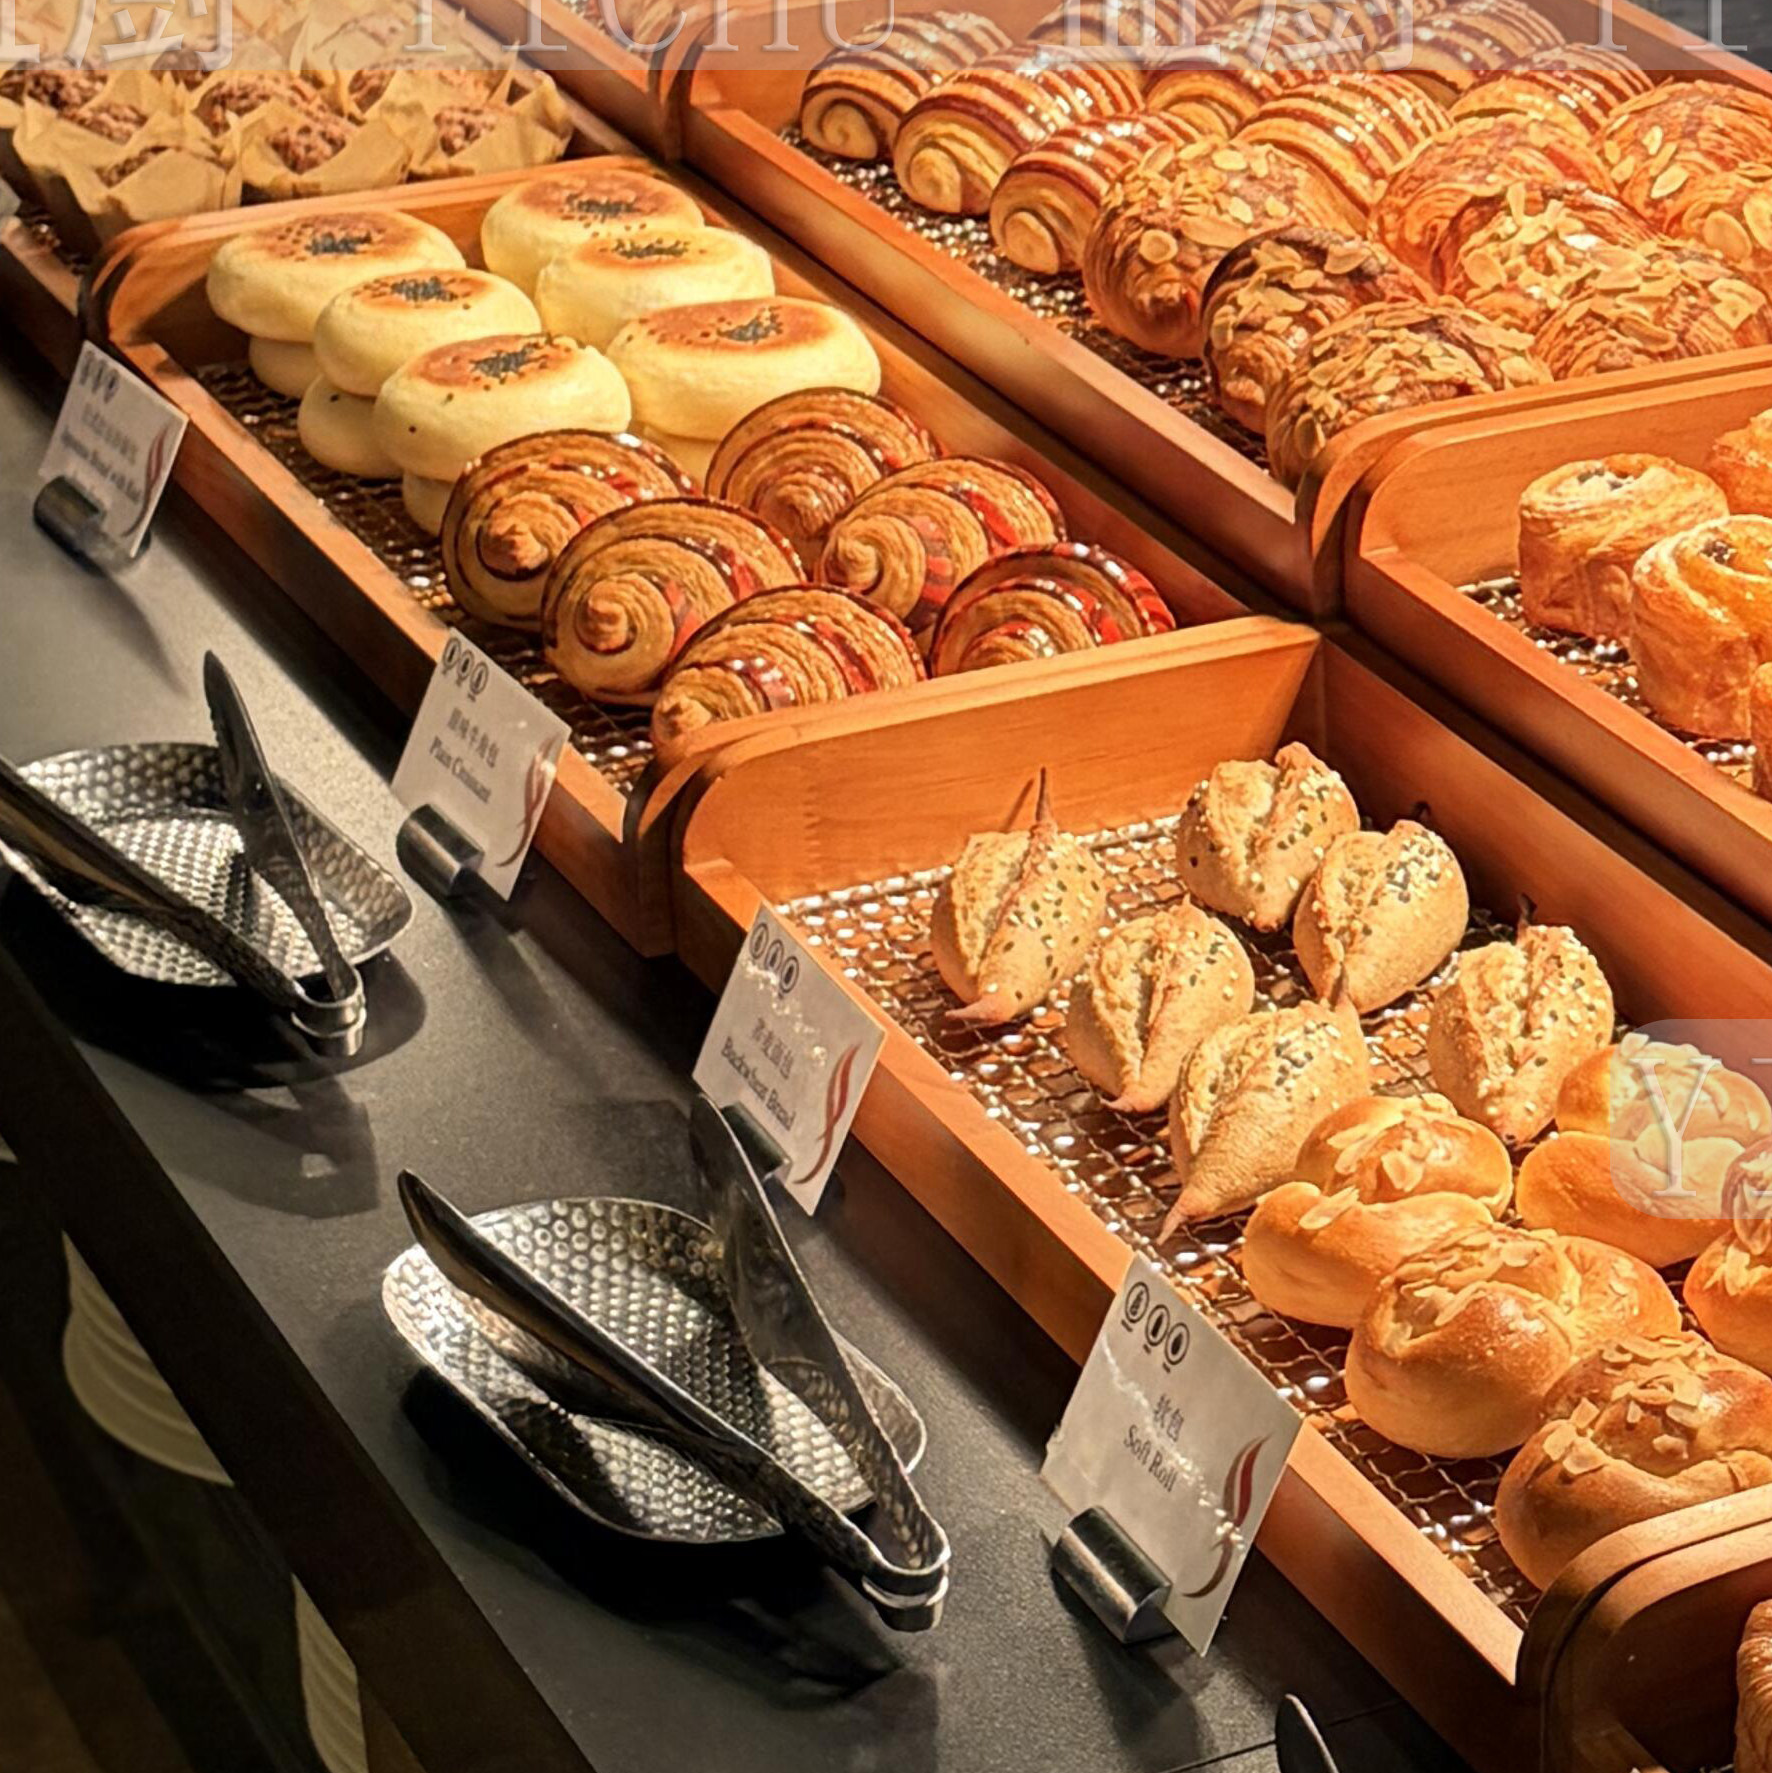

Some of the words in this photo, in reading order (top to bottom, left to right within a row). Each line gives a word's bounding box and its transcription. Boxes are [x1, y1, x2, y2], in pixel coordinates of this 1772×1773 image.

[1152, 1391, 1185, 1443] 软包
[1123, 1423, 1151, 1466] Soft
[1148, 1449, 1180, 1493] Roll
